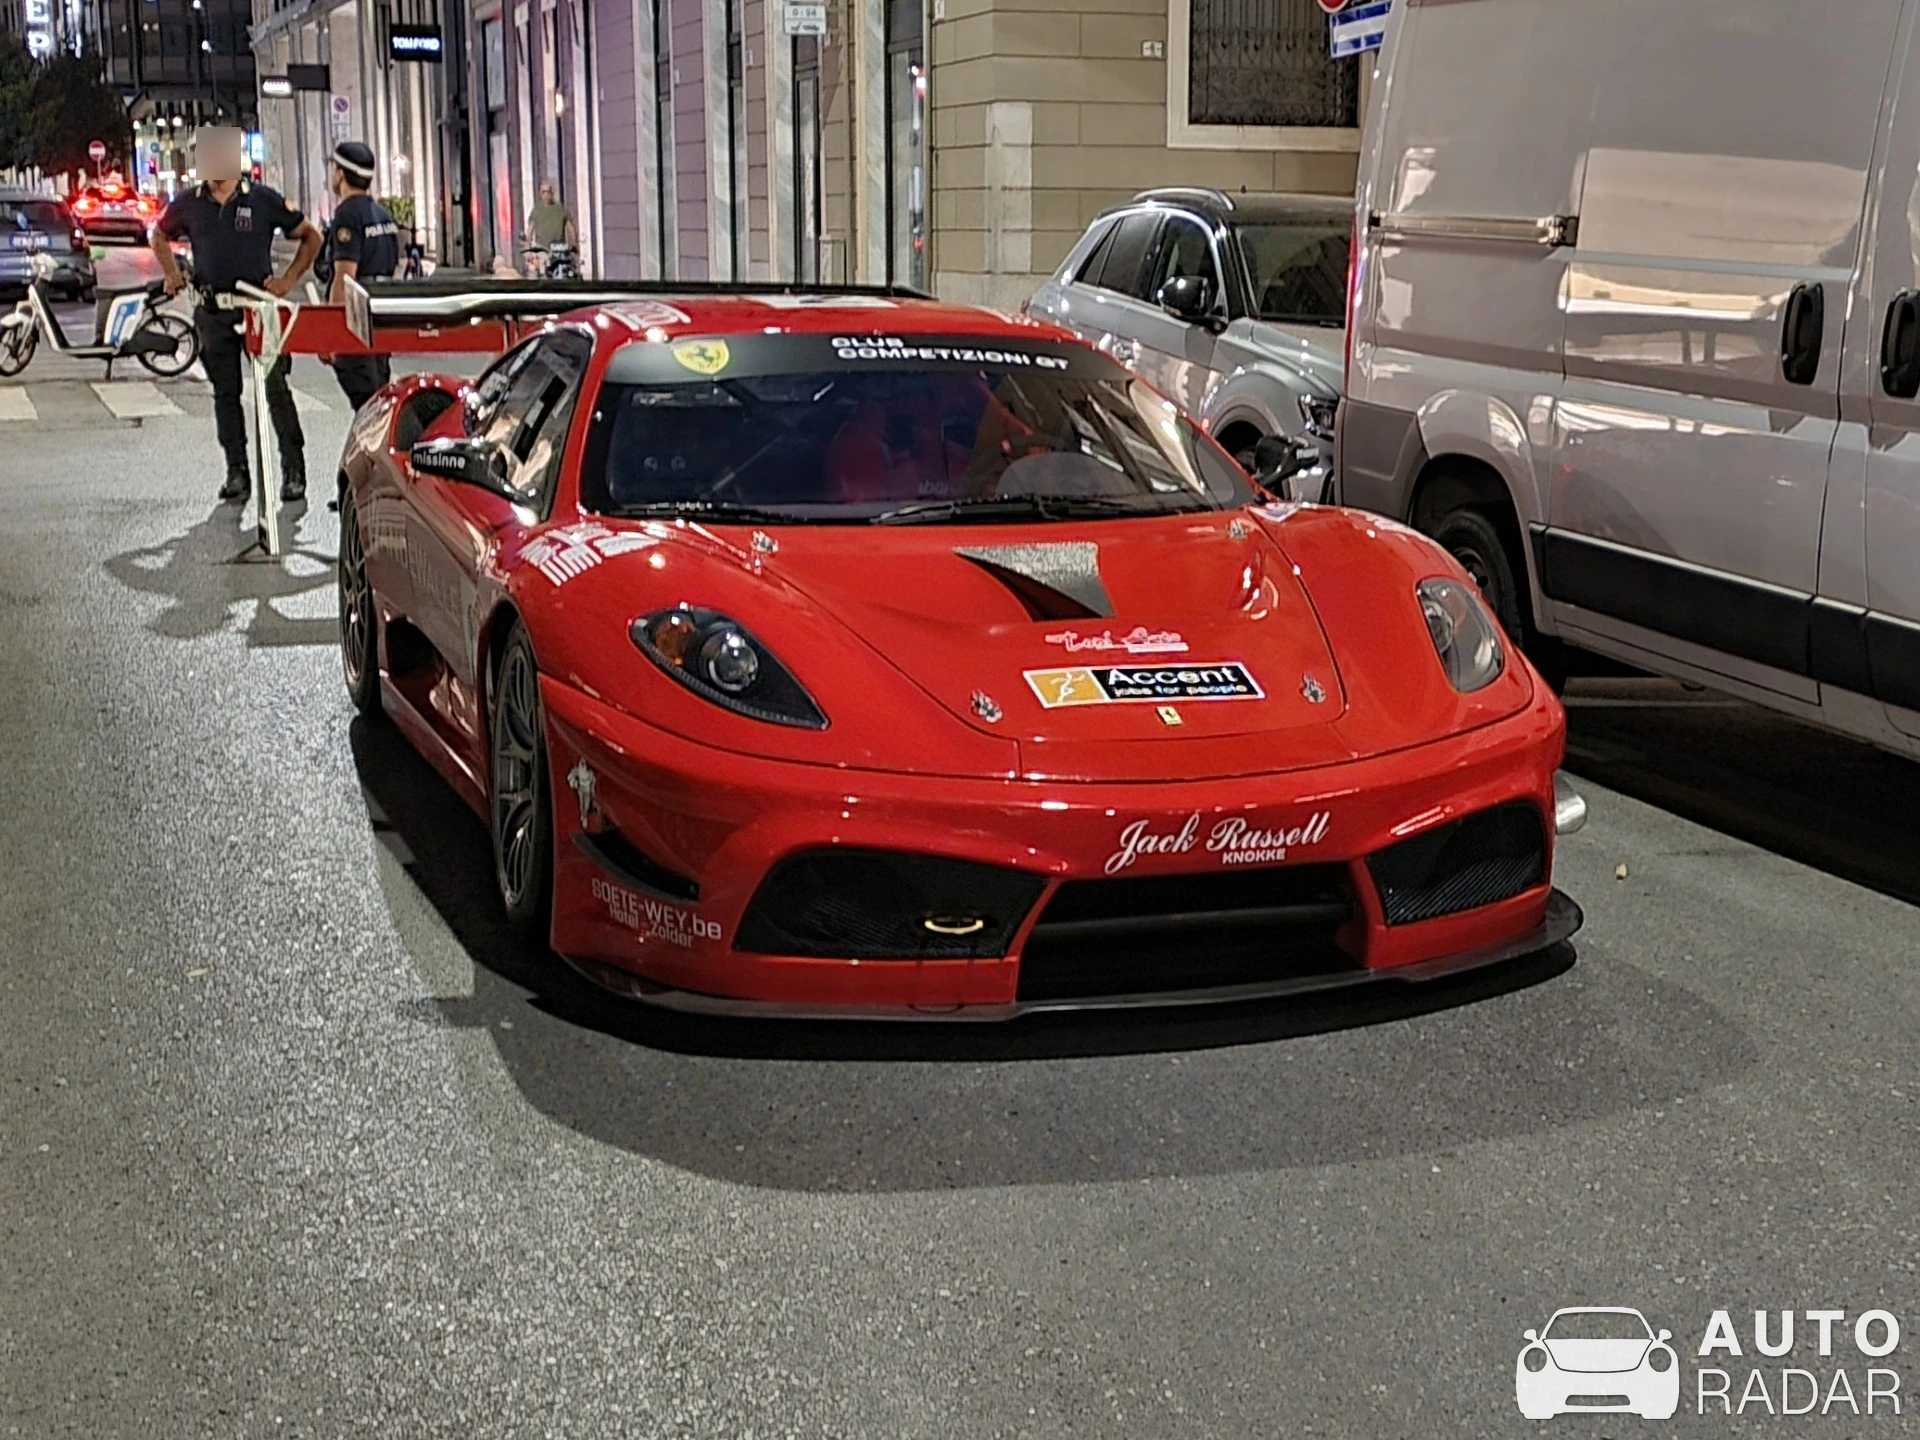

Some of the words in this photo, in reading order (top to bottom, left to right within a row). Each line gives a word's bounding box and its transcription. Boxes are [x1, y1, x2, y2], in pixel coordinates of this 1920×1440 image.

[413, 37, 440, 50] FORD
[837, 347, 1031, 365] COMPETIZIONI
[1035, 356, 1069, 370] GT
[1108, 667, 1238, 686] Accent
[1155, 685, 1180, 695] for
[1186, 684, 1248, 696] people
[1104, 812, 1201, 875] Jack
[1205, 810, 1331, 852] Russell
[1222, 847, 1287, 865] KNOKKE
